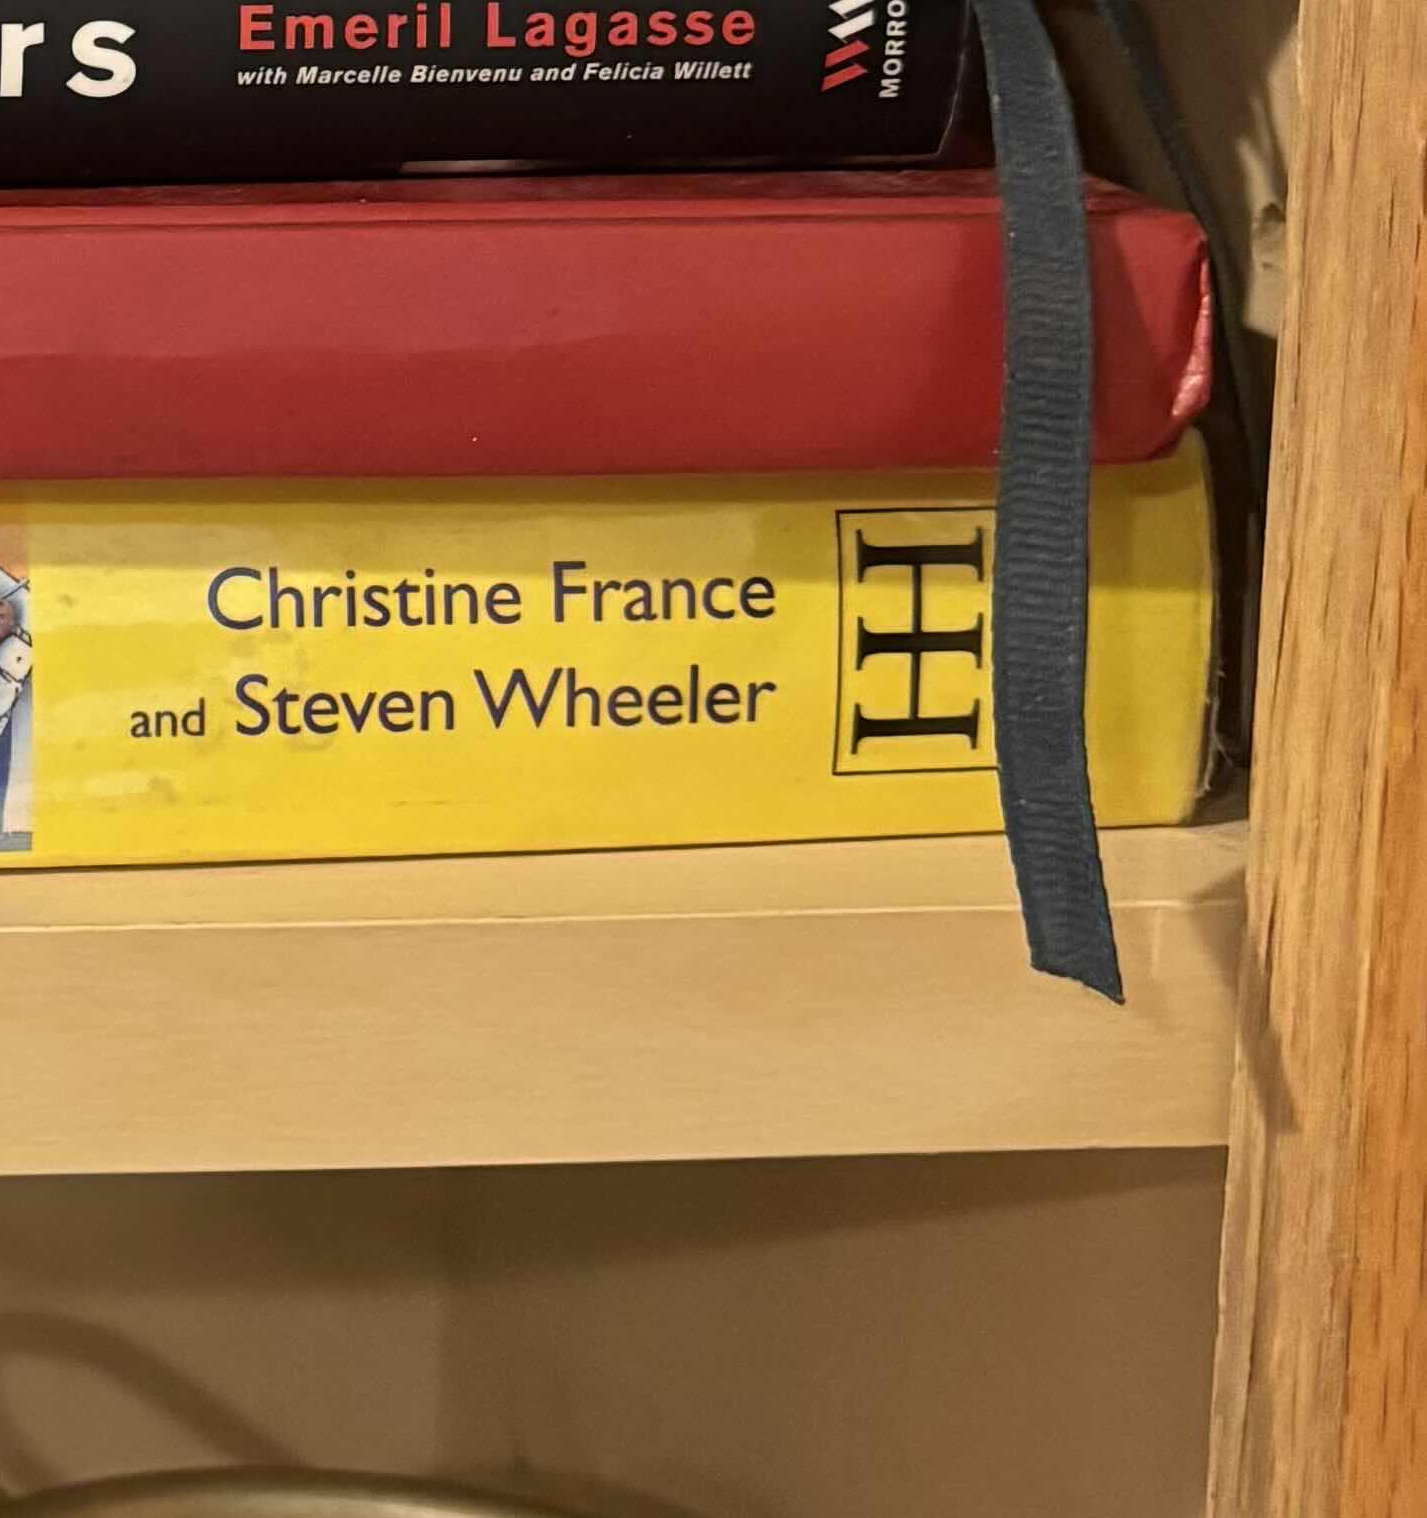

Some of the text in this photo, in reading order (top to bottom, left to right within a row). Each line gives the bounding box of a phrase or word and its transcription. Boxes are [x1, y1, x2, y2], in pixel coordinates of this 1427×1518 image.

[238, 0, 756, 58] Emeril Lagasse
[236, 61, 753, 86] with Marcelle Bienvenu and Felicia Willett
[207, 559, 776, 631] Christine France
[130, 662, 777, 739] and Steven Wheeler
